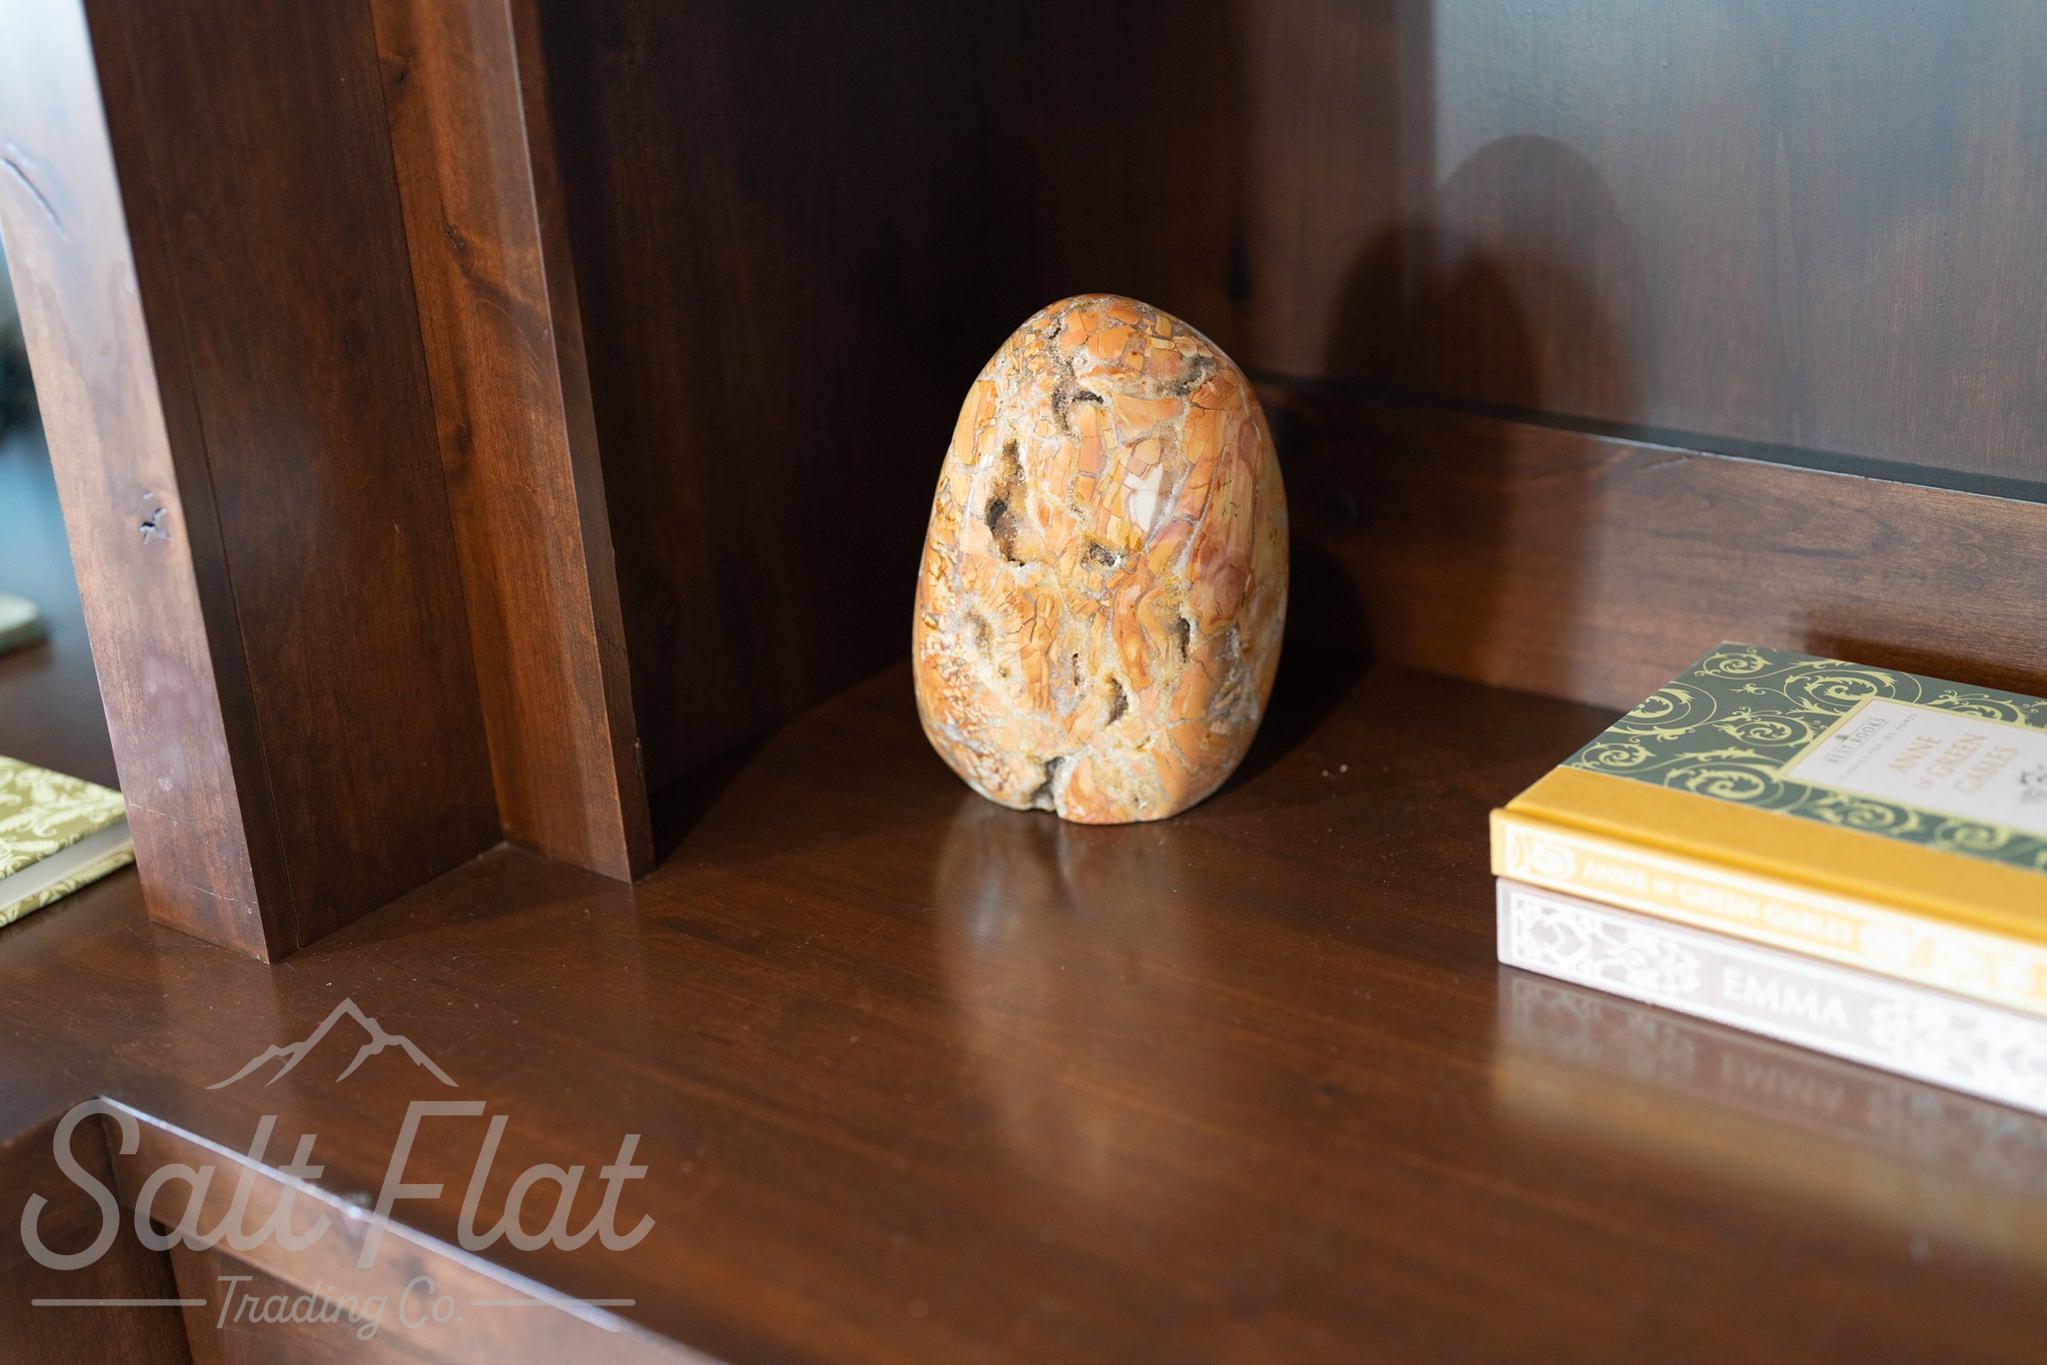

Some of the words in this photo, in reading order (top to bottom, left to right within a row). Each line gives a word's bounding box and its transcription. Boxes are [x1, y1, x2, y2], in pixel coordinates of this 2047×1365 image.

[1849, 717, 1886, 744] BOOKS
[1887, 735, 1943, 775] ANNE
[1926, 731, 1988, 778] GREEN
[1582, 860, 1649, 894] ANNE
[1722, 967, 1852, 1030] EMMA
